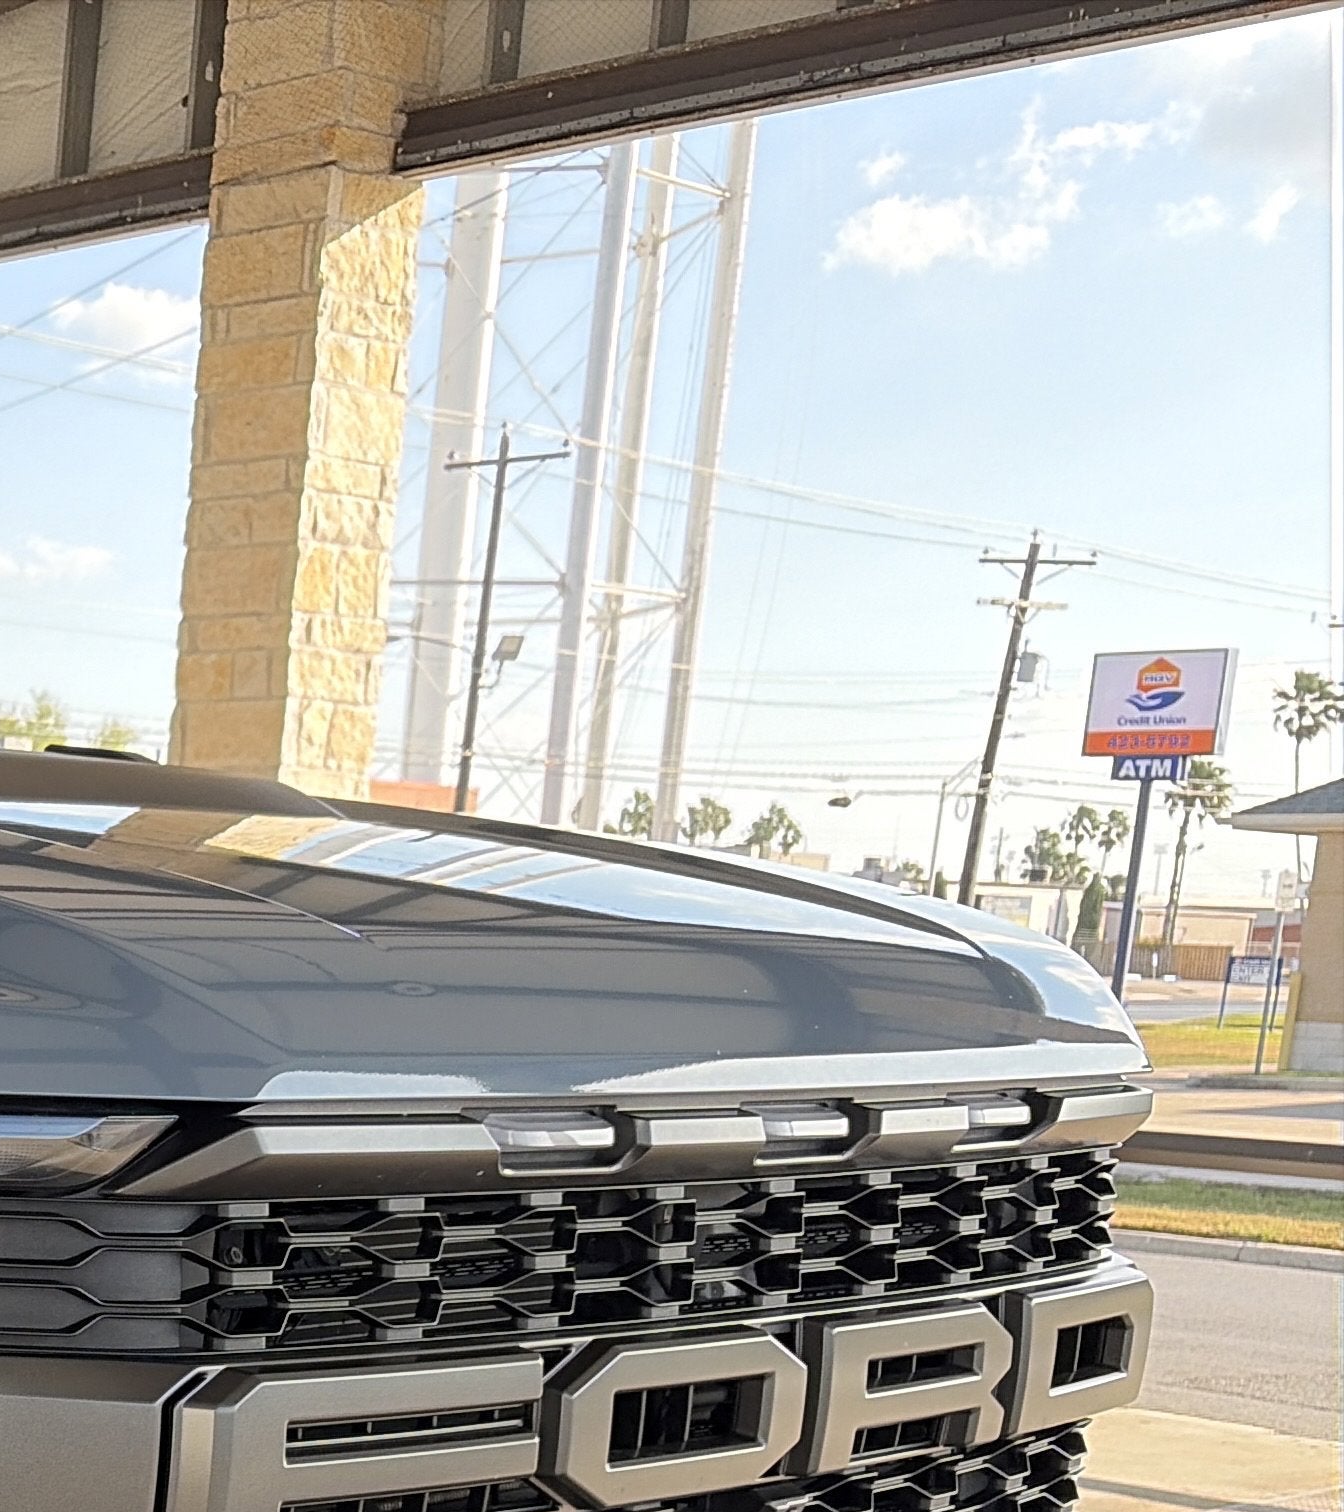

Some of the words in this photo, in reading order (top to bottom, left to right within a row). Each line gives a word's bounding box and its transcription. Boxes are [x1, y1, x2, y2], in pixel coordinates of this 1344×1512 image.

[1117, 715, 1150, 726] Credit
[1153, 714, 1187, 725] Union
[1118, 759, 1173, 778] ATM
